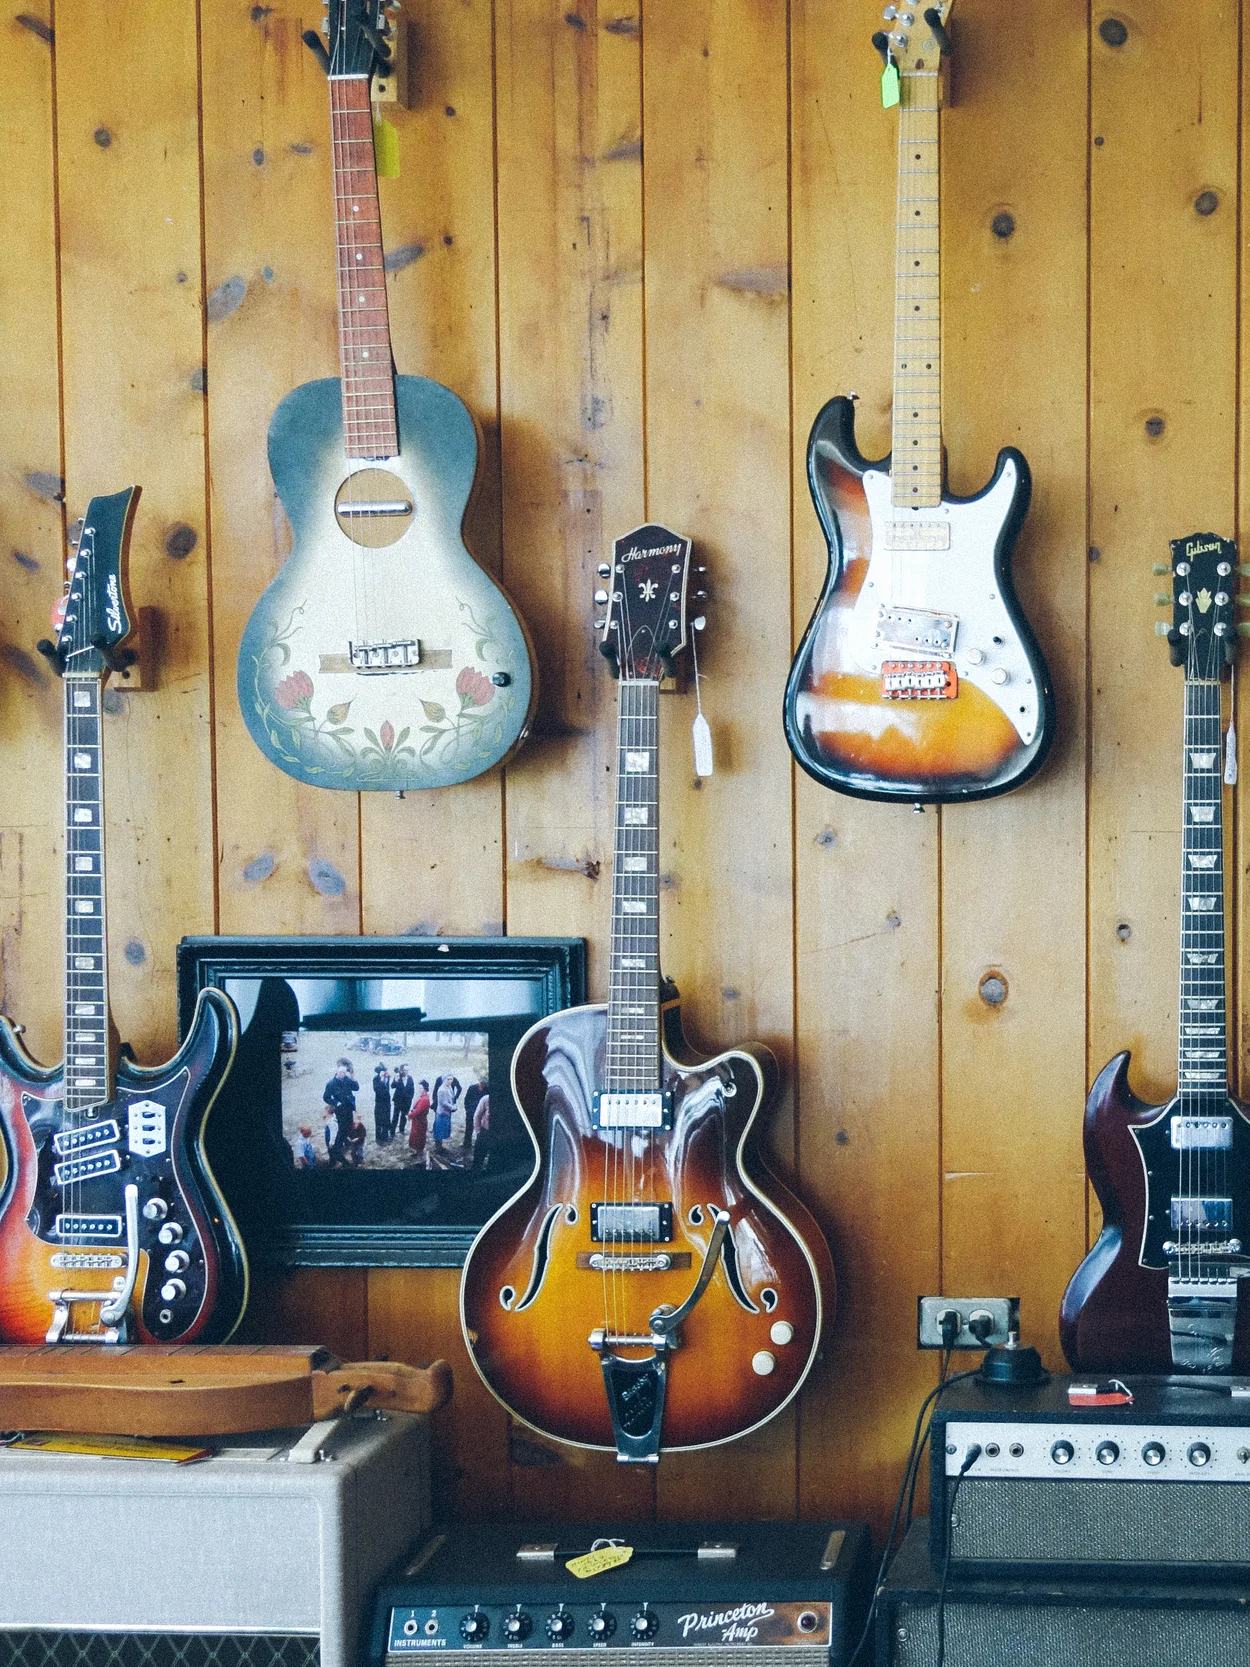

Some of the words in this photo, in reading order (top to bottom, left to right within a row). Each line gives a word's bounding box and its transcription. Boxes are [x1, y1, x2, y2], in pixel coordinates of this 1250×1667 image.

[621, 543, 682, 563] Harmony
[1186, 540, 1222, 562] Gibson
[105, 574, 122, 634] Silvertone
[678, 1602, 775, 1637] Princeton
[394, 1639, 447, 1647] INSTRUMENTS
